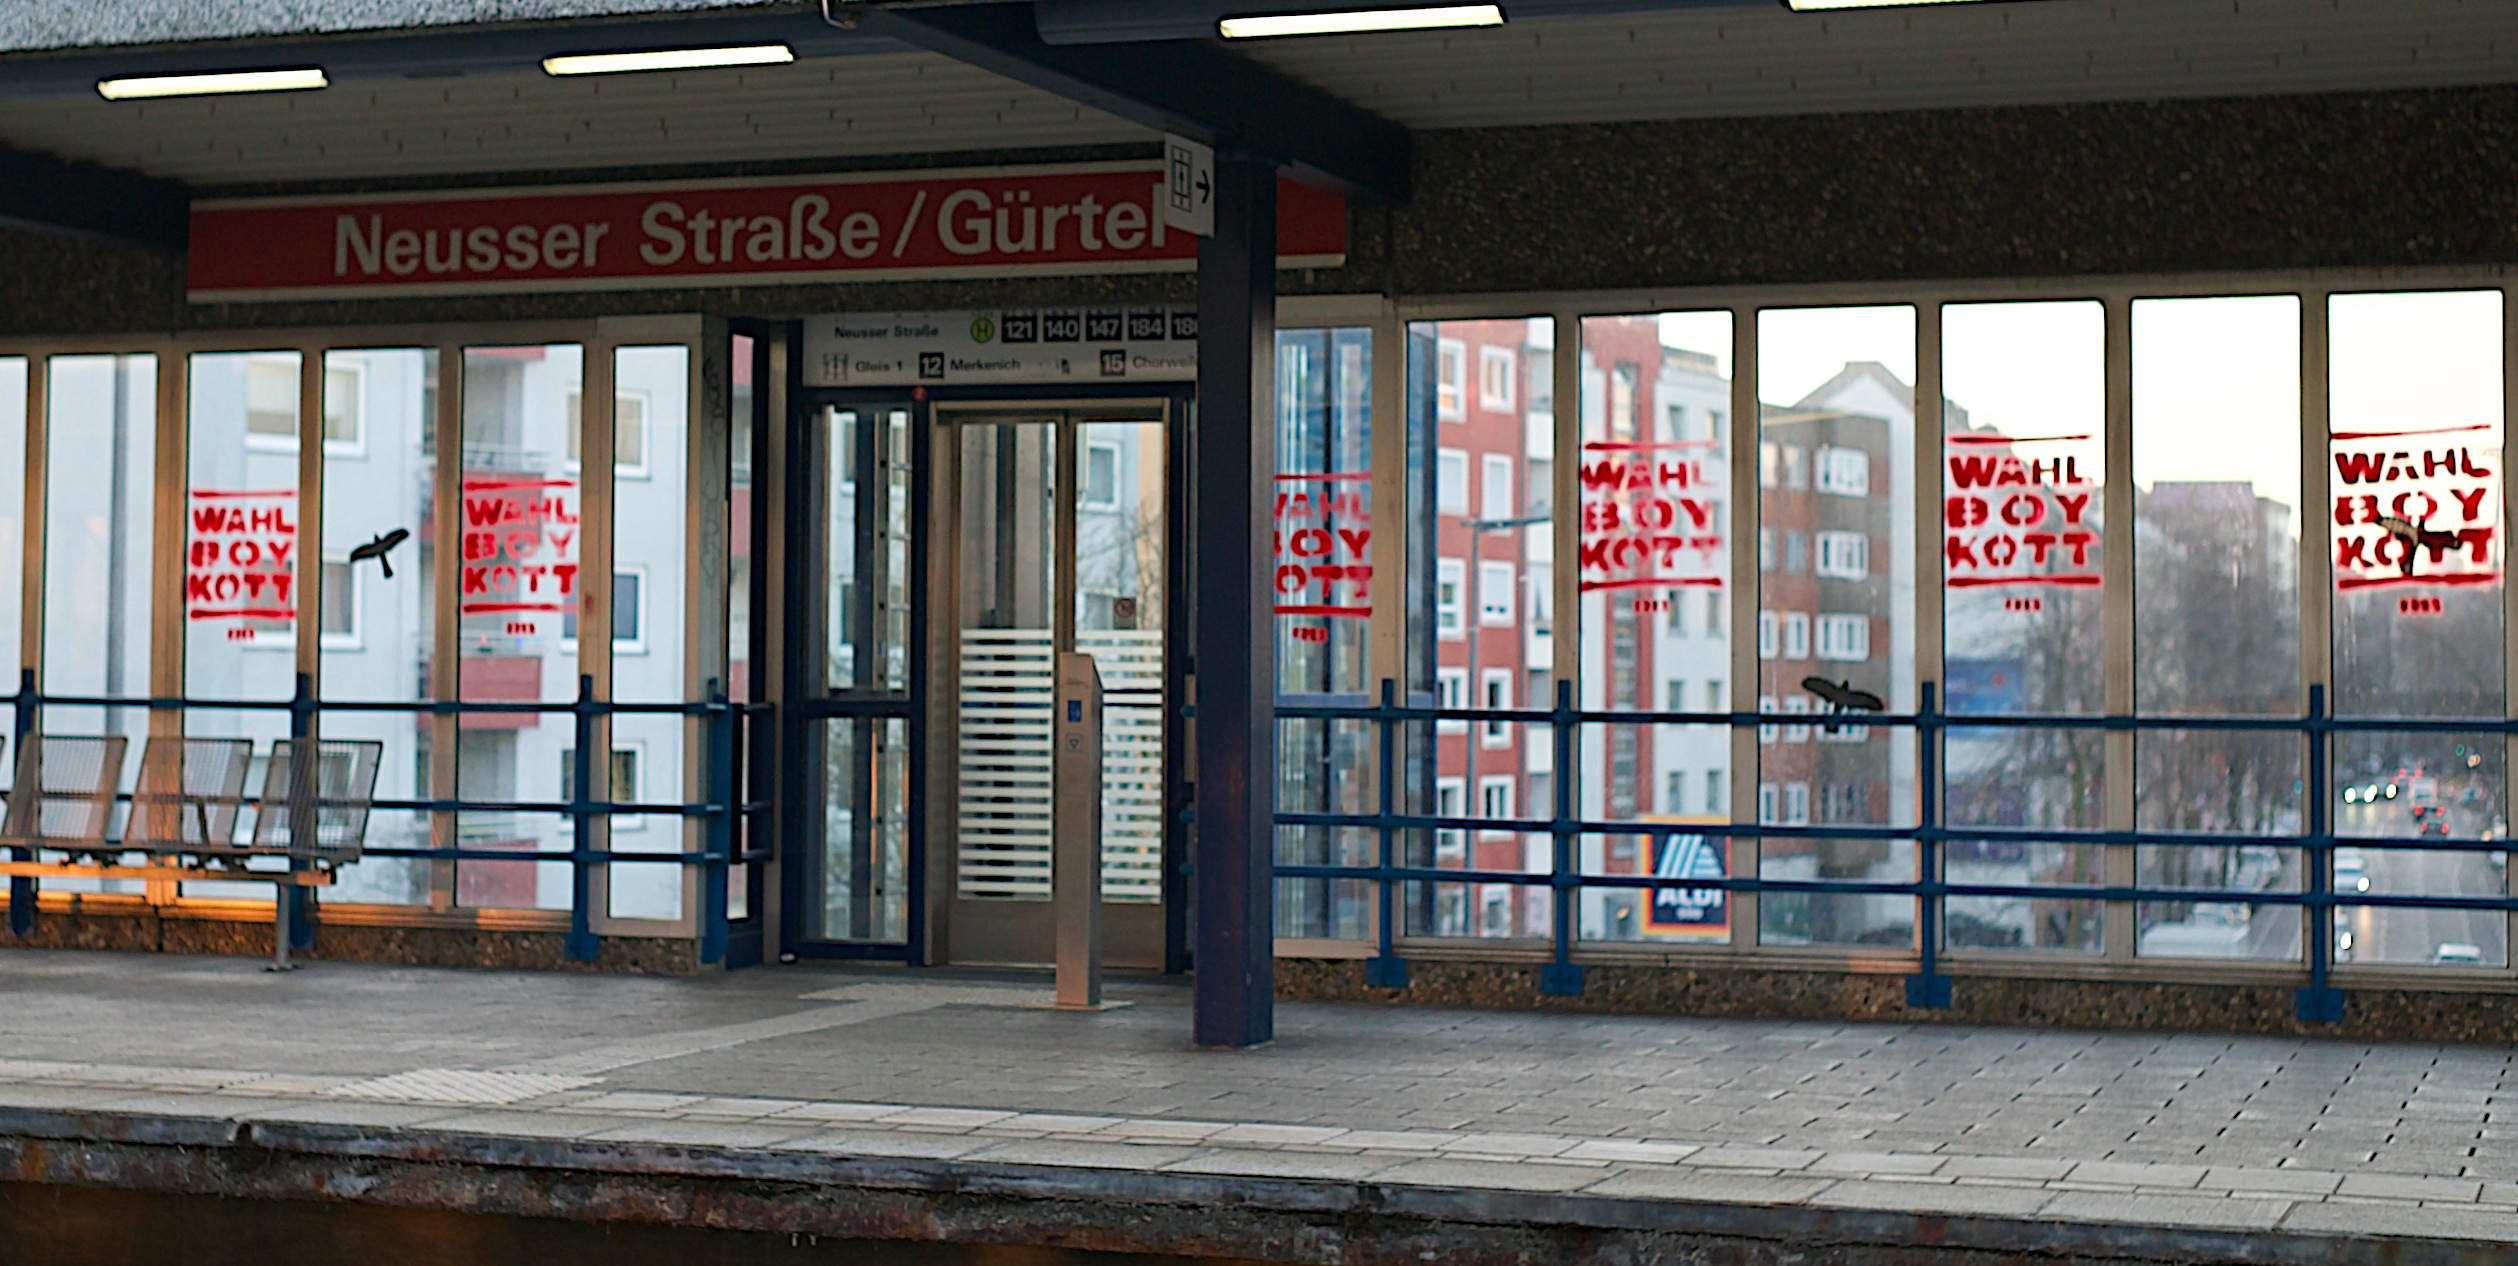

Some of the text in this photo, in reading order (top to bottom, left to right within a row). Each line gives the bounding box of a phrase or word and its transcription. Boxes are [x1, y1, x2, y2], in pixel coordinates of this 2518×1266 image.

[333, 212, 610, 277] Neusser
[639, 193, 880, 266] Straße
[937, 182, 1166, 256] Gürtel
[834, 324, 939, 339] Neusser Straße
[1005, 321, 1033, 339] 121
[1046, 320, 1078, 338] 140
[1091, 318, 1120, 337] 147
[1130, 317, 1163, 337] 184
[856, 360, 890, 373] Gleis
[922, 356, 1021, 375] 12 Merkenich
[1102, 353, 1124, 373] 15
[1581, 461, 1718, 491] WAHL
[1949, 456, 2092, 488] WAHL
[2335, 447, 2491, 484] WAHL
[193, 507, 295, 533] WAHL
[465, 497, 577, 526] WAHL
[1584, 499, 1713, 533] BOY
[1947, 494, 2088, 528] BOY
[2335, 488, 2486, 525] BOY
[191, 540, 292, 567] BOY
[464, 530, 573, 560] BOY
[1581, 537, 1722, 571] KOTT
[1947, 533, 2099, 569] KOTT
[2337, 528, 2493, 567] KOTT
[189, 574, 292, 602] KOTT
[464, 564, 577, 595] KOTT
[1657, 886, 1723, 907] ALDI
